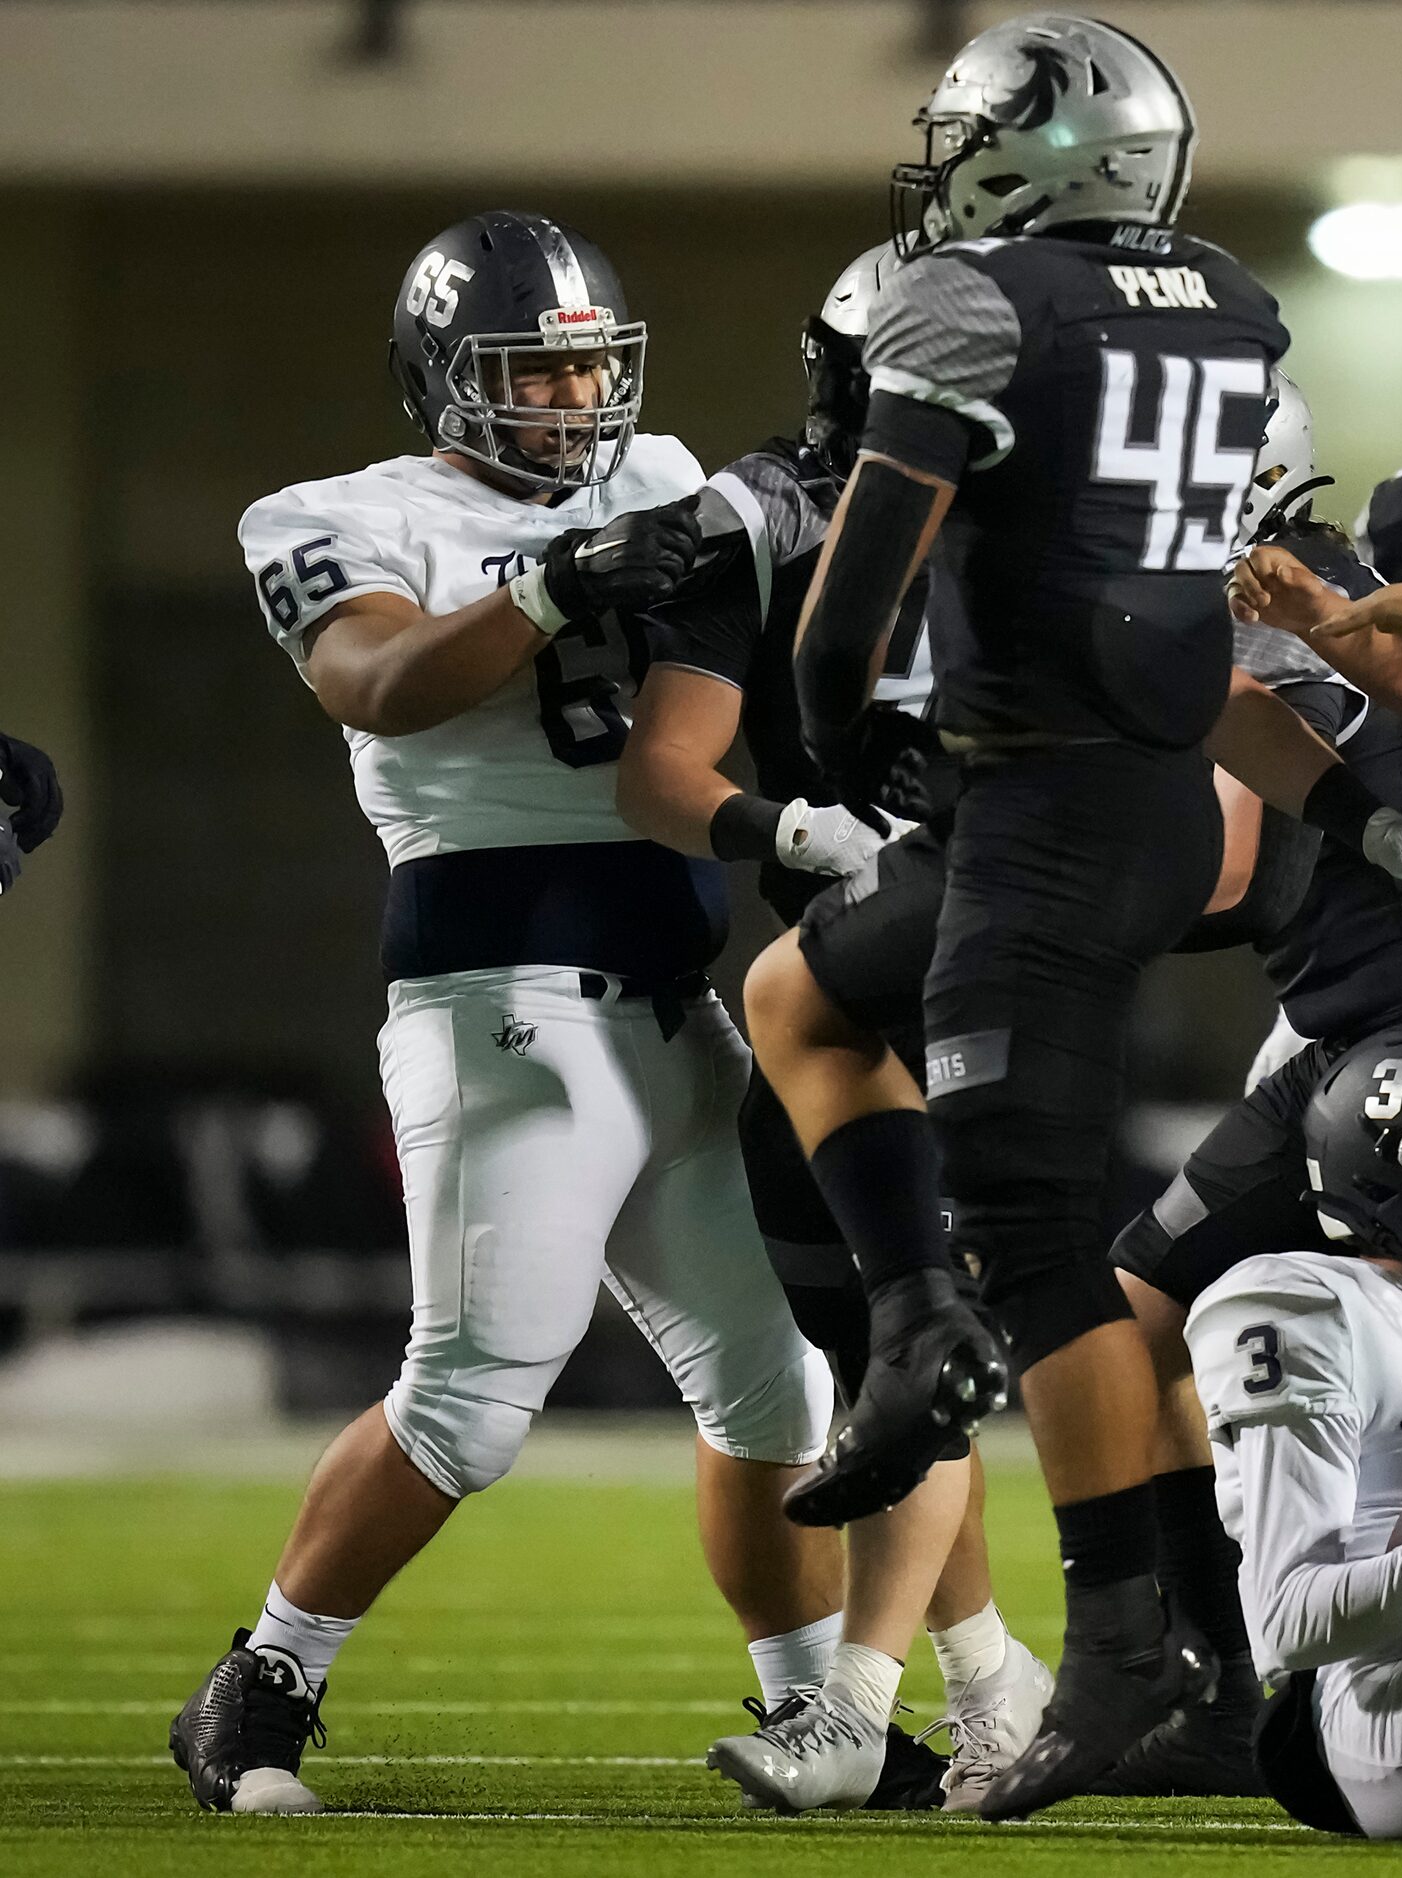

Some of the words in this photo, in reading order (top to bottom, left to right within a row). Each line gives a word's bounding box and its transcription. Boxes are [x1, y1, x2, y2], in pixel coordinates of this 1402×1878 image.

[406, 250, 476, 329] 65
[557, 308, 598, 324] Riddell
[1107, 264, 1218, 310] PENA
[1090, 349, 1266, 571] 45
[258, 535, 350, 633] 65
[1236, 1323, 1284, 1396] 3
